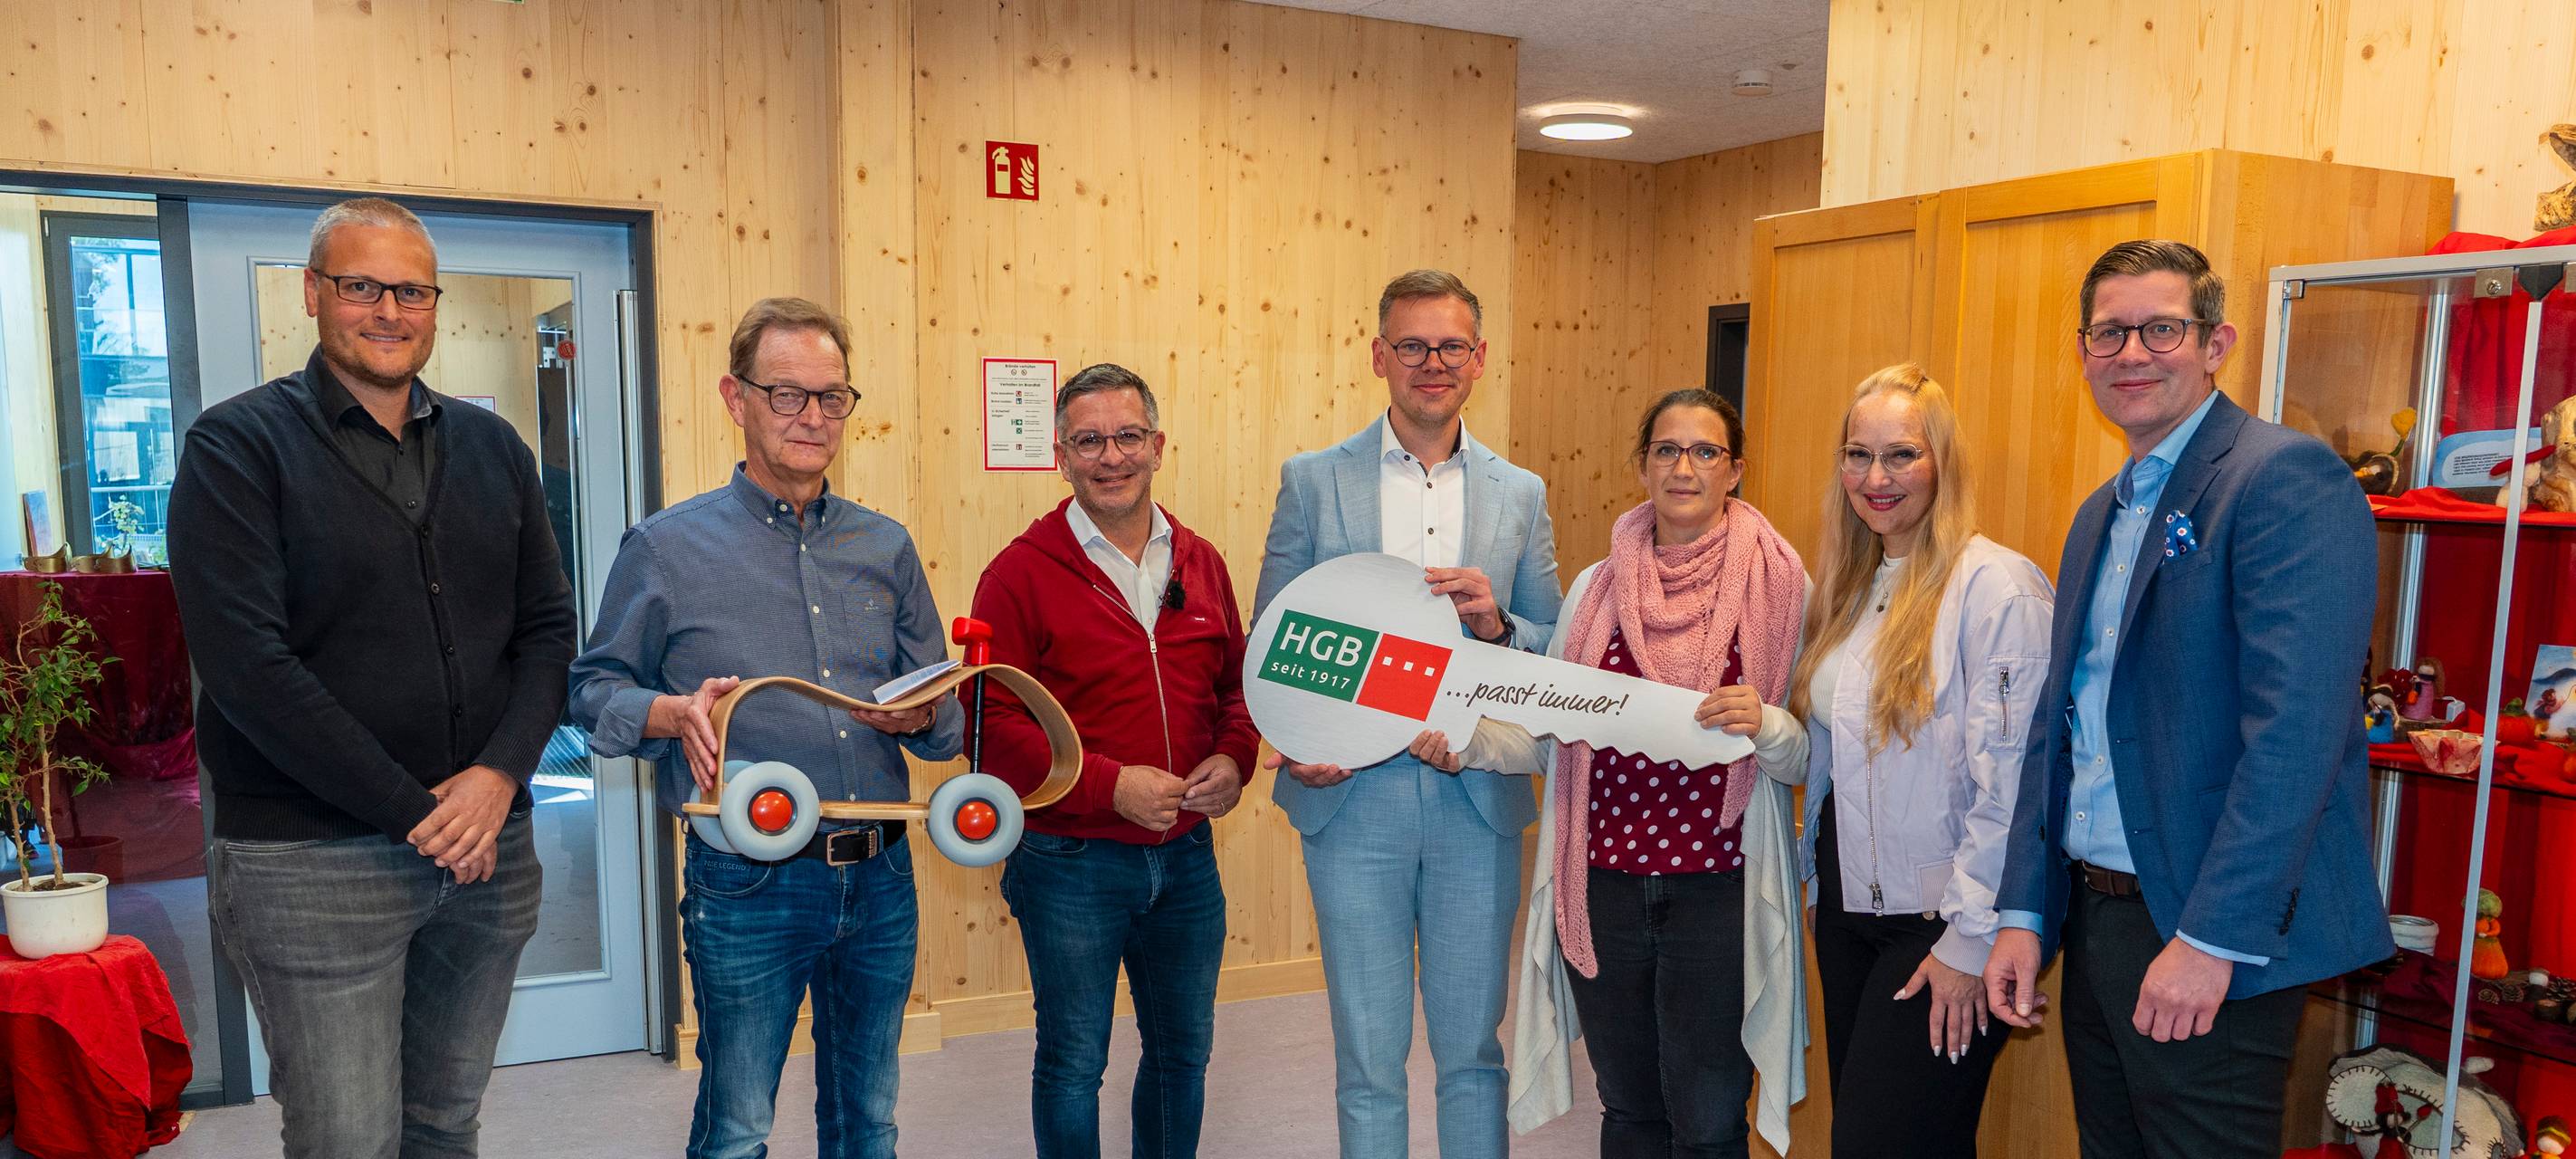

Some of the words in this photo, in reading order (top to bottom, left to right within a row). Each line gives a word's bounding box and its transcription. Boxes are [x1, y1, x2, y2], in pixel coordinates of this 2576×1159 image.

[1279, 621, 1363, 667] HGB
[1271, 661, 1305, 678] seit
[1310, 670, 1351, 689] 1917
[1537, 683, 1629, 716] immer!
